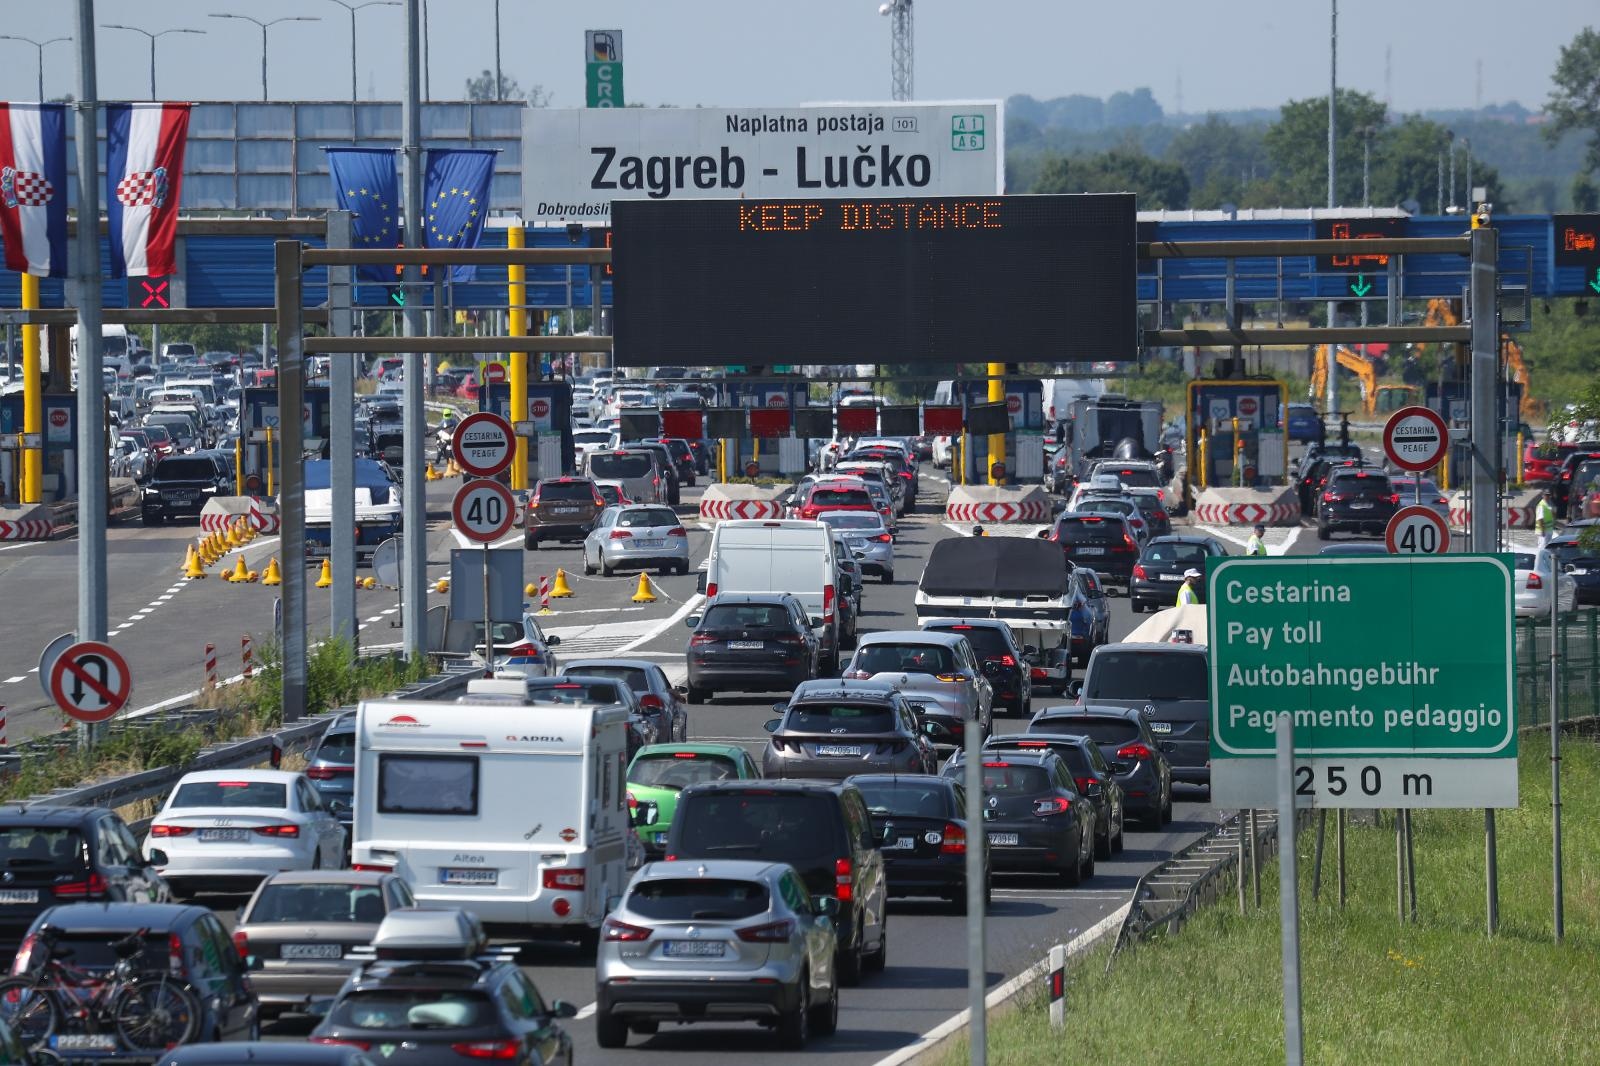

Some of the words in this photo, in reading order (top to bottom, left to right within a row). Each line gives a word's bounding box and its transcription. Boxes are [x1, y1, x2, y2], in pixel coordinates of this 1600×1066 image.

[726, 114, 808, 136] Naplatna
[817, 113, 884, 136] postaja
[897, 119, 914, 130] 101
[590, 146, 746, 199] Zagreb
[796, 144, 931, 189] Lučko
[537, 202, 609, 216] Dobrodošli
[739, 204, 823, 231] KEEP
[840, 202, 1002, 230] DISTANCE
[464, 430, 503, 441] CESTARINA
[1395, 425, 1435, 435] CESTARINA
[471, 448, 497, 458] PEAGE
[1403, 444, 1428, 453] PEAGE
[467, 496, 502, 526] 40
[1400, 523, 1436, 553] 40
[1226, 579, 1351, 604] Cestarina
[1227, 621, 1274, 650] Pay
[1282, 620, 1322, 644] toll
[1227, 661, 1440, 692] Autobahngebühr
[1384, 703, 1502, 733] pedaggio
[1294, 765, 1382, 796] 250
[1402, 773, 1433, 796] m
[452, 853, 485, 864] Altea
